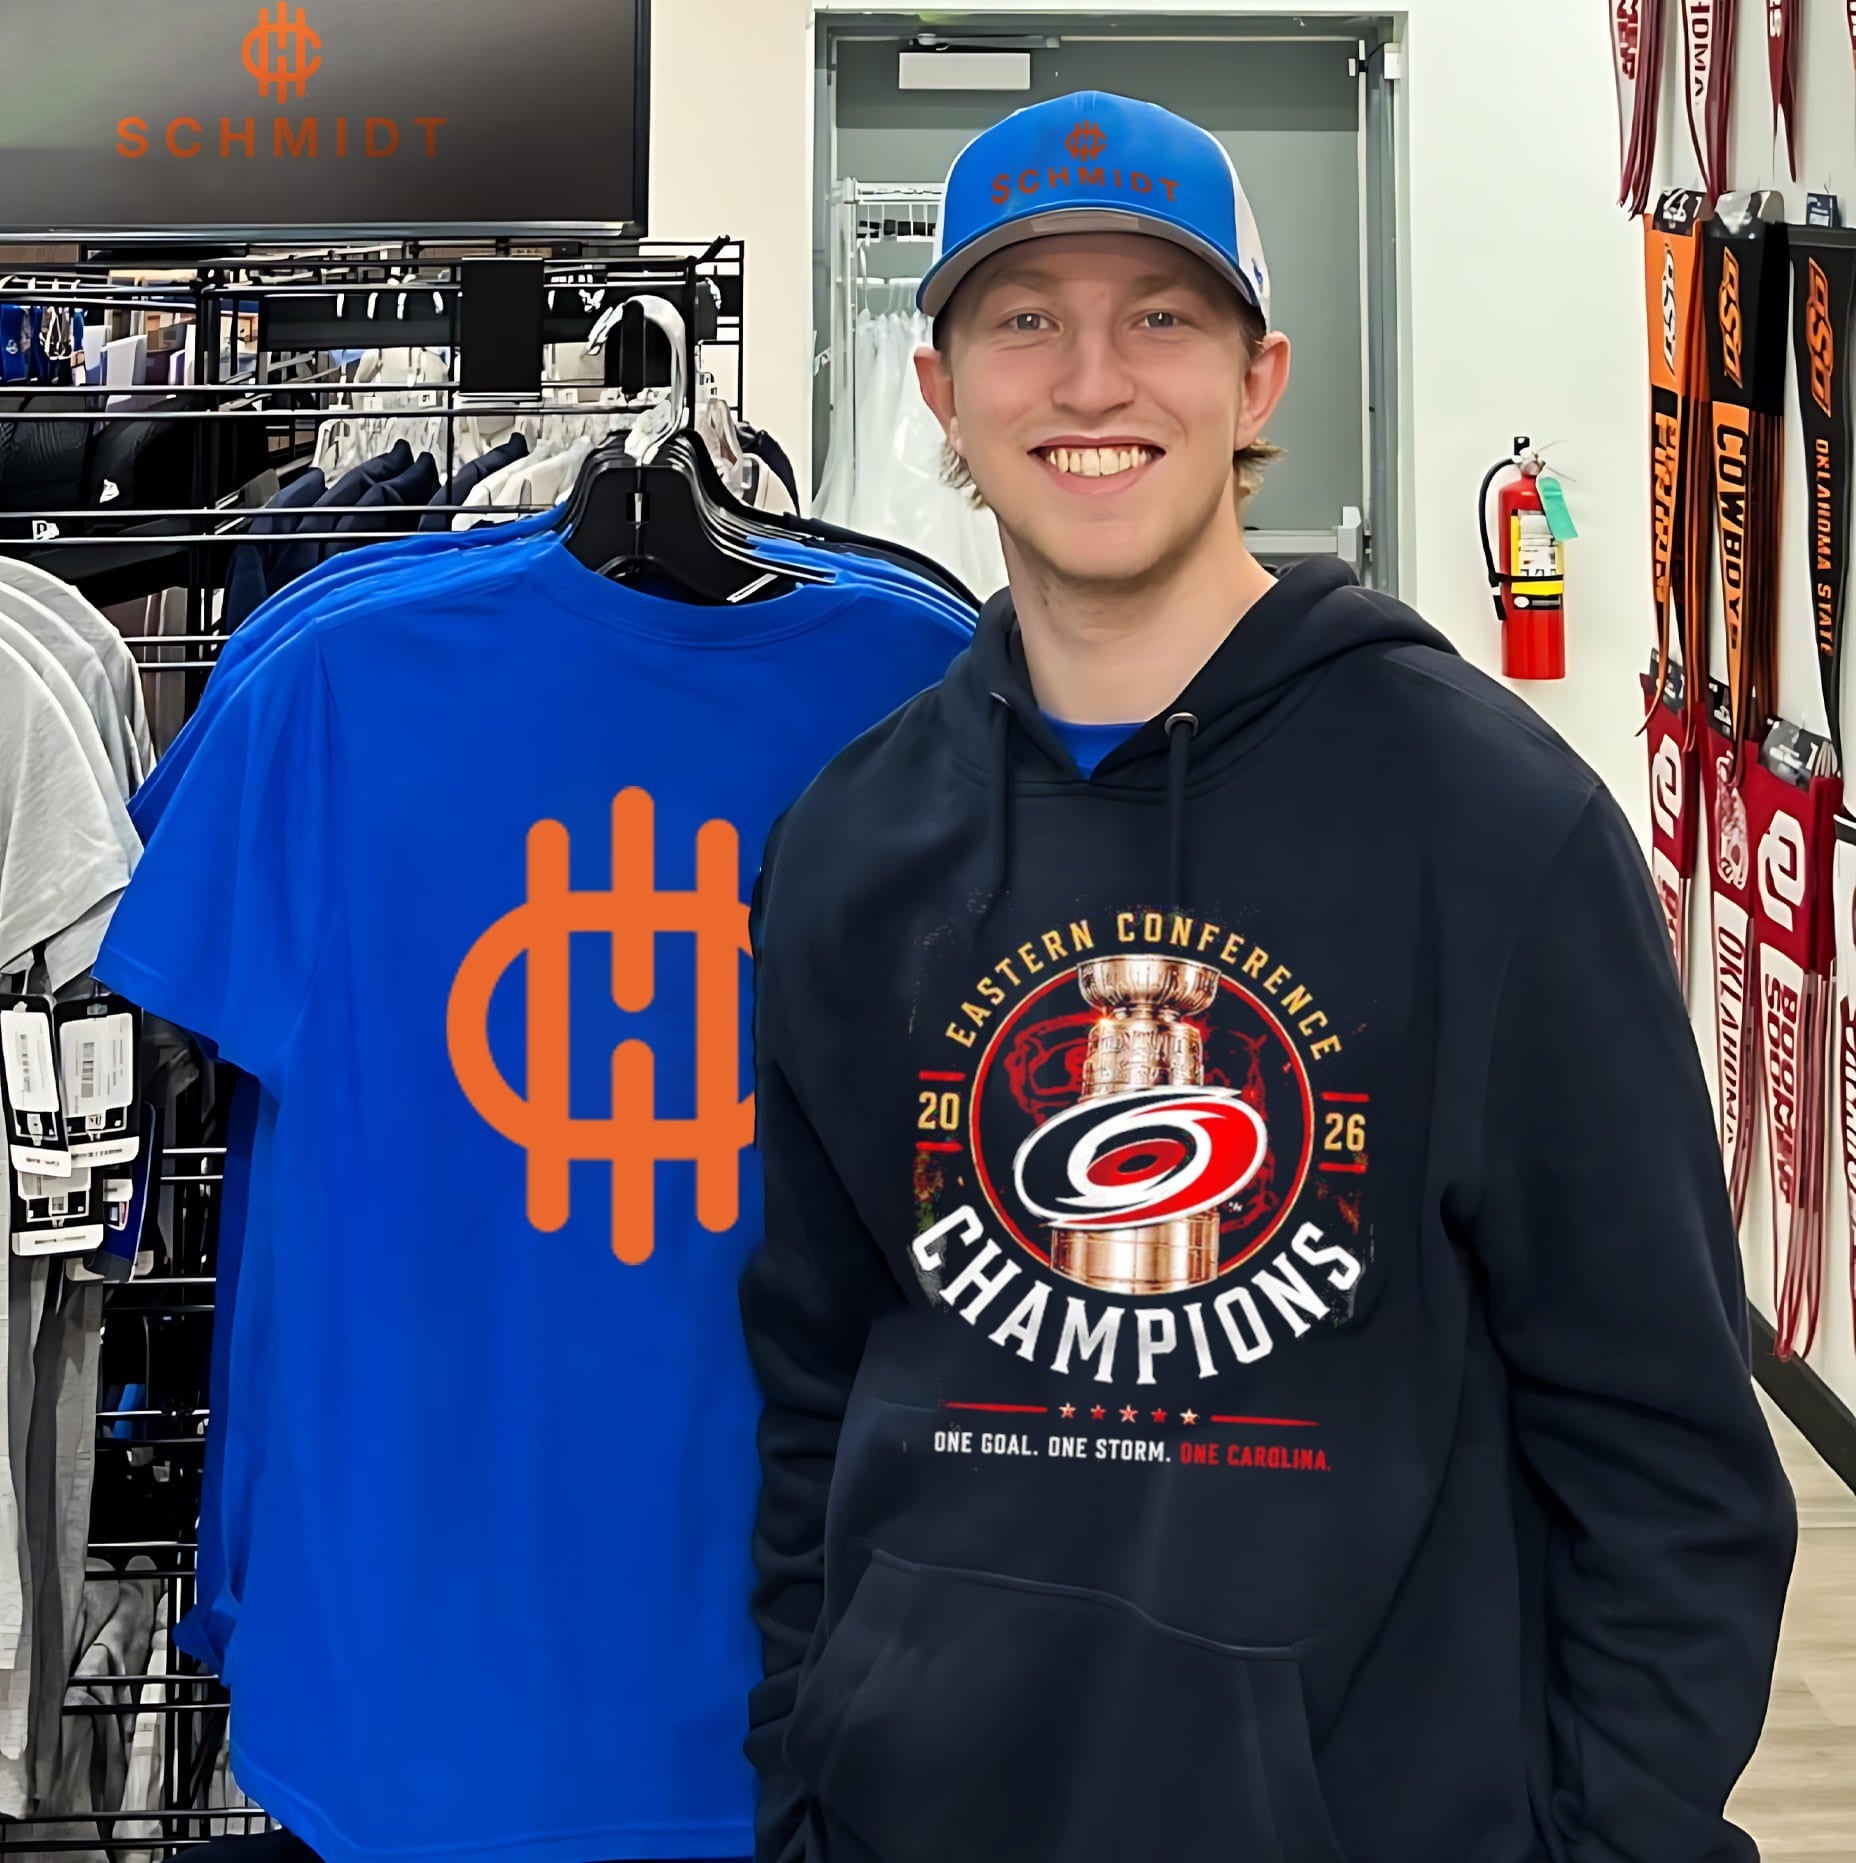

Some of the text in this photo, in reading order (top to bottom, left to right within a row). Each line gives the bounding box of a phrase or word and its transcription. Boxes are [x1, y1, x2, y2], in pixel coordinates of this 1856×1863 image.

[116, 116, 447, 158] SCHMIDT
[991, 166, 1179, 204] SCHMIDT
[1815, 438, 1832, 570] OKLAHOMA
[945, 912, 1343, 1061] EASTERN CONFERENCE
[917, 1091, 960, 1131] 20
[1324, 1112, 1366, 1152] 26
[911, 1205, 1362, 1385] CHAMPIONS
[934, 1431, 1332, 1472] ONE GOAL. ONE STORM. ONE CAROLINA.
